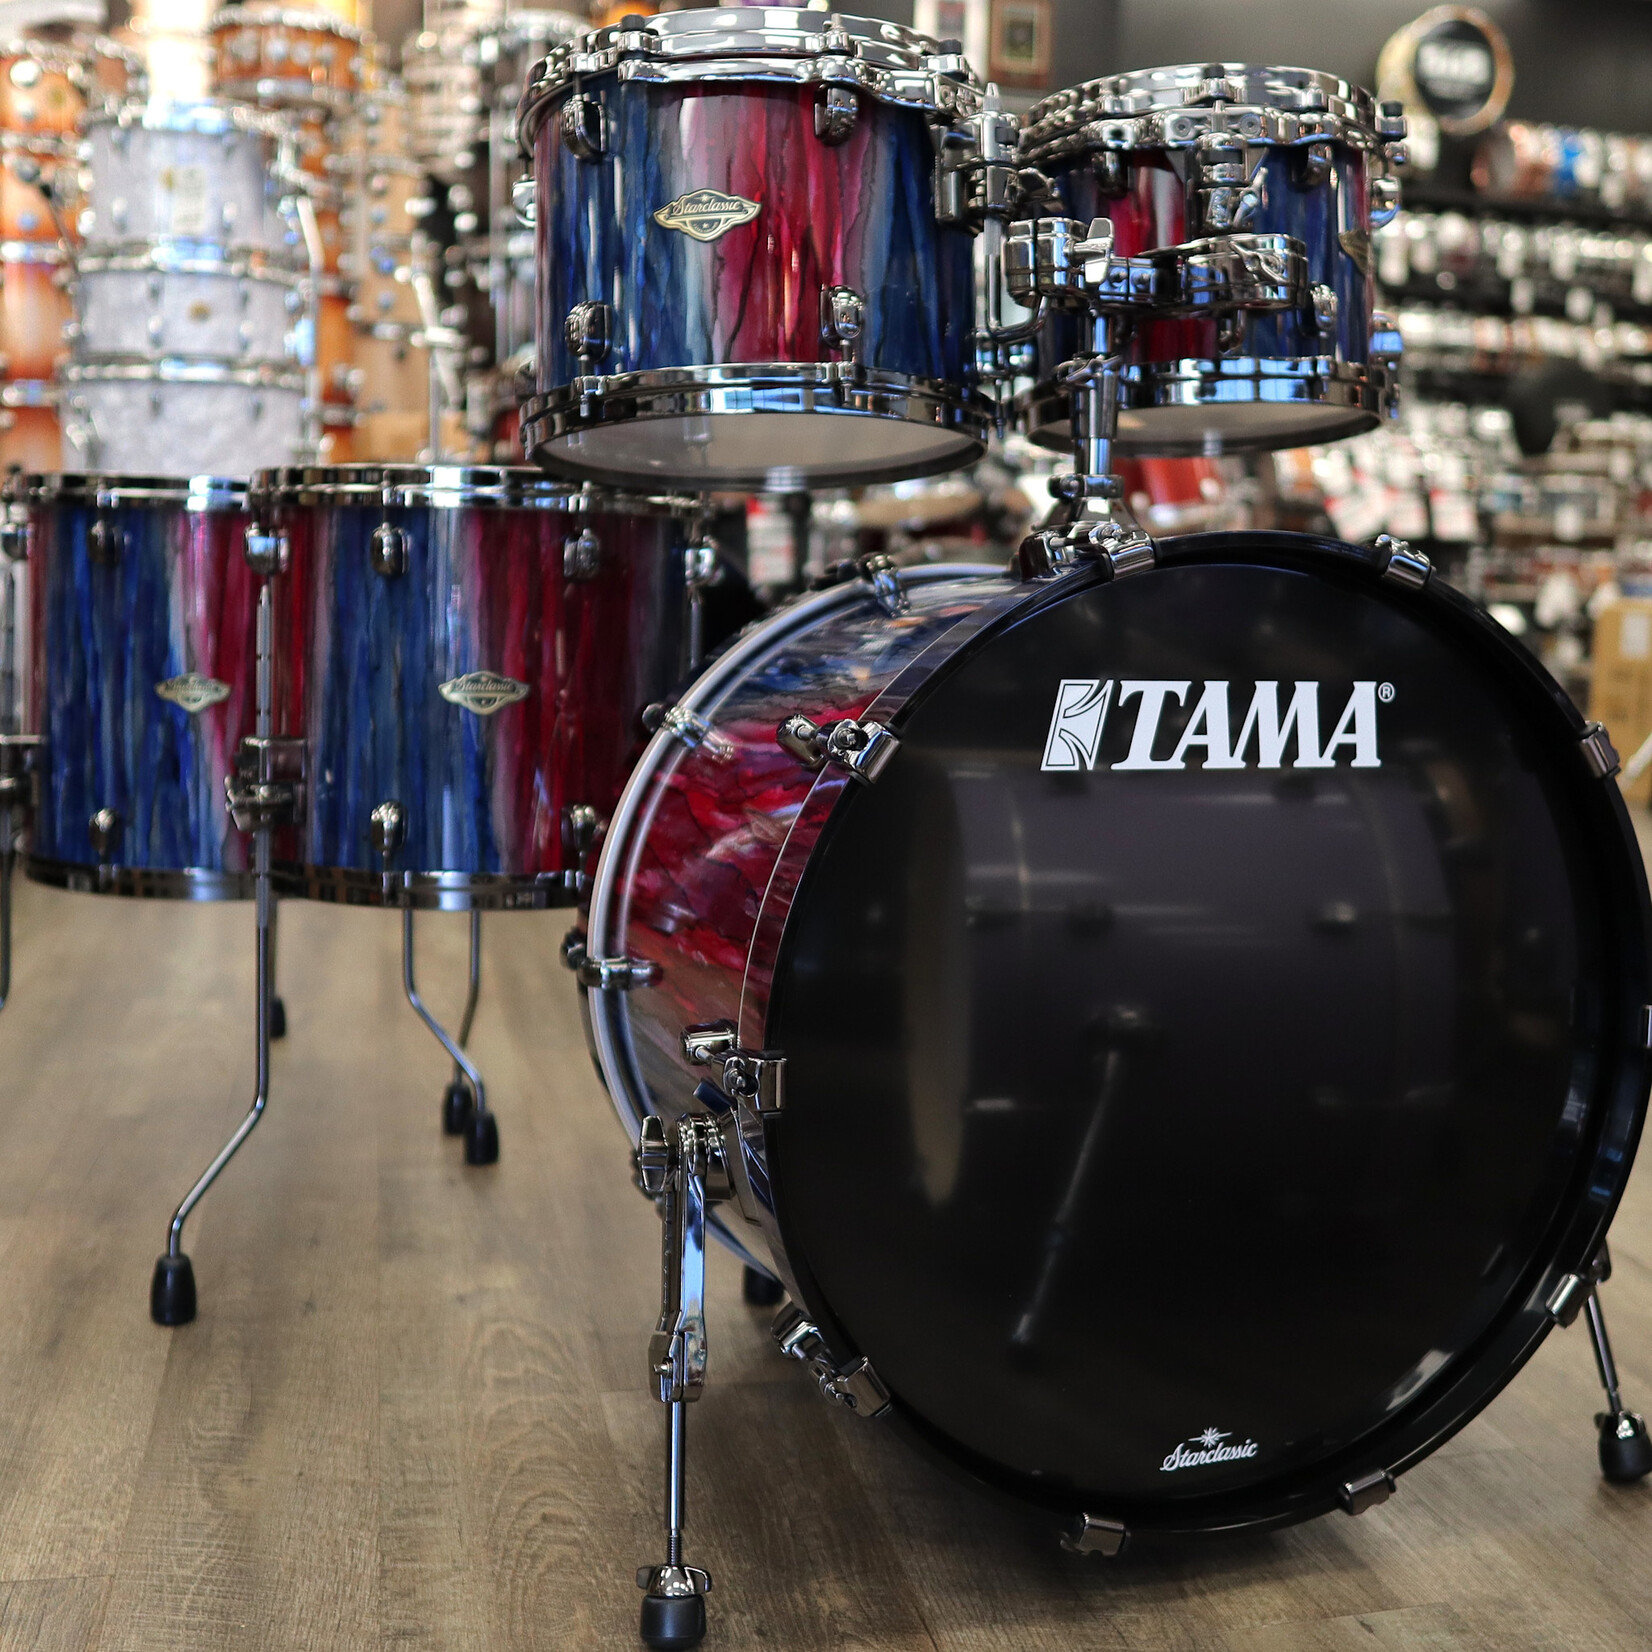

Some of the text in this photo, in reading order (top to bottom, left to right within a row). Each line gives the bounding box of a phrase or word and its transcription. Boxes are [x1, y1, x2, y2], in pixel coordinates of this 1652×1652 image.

[672, 198, 740, 215] Starclassic
[1110, 680, 1382, 770] TAMA
[1159, 1438, 1258, 1471] Starclassic
